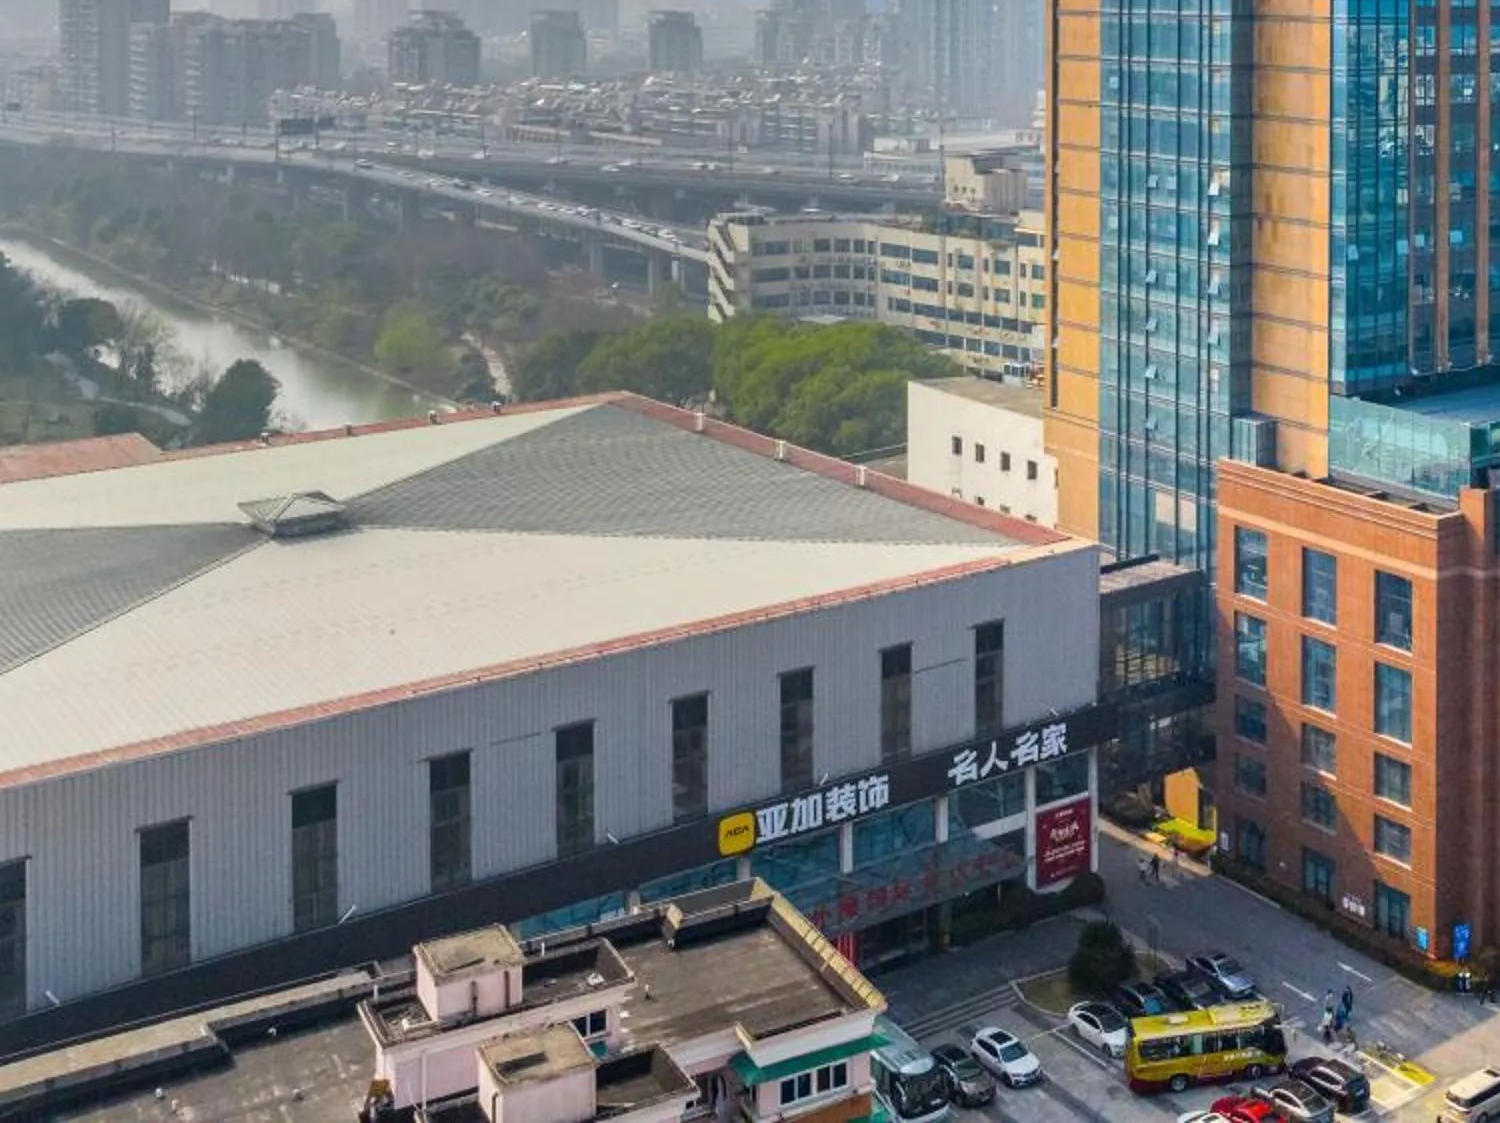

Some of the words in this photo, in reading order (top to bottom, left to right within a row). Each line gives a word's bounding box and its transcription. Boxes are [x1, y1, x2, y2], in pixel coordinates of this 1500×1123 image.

[755, 775, 889, 844] 亚加装饰
[948, 723, 1067, 785] 名人名家
